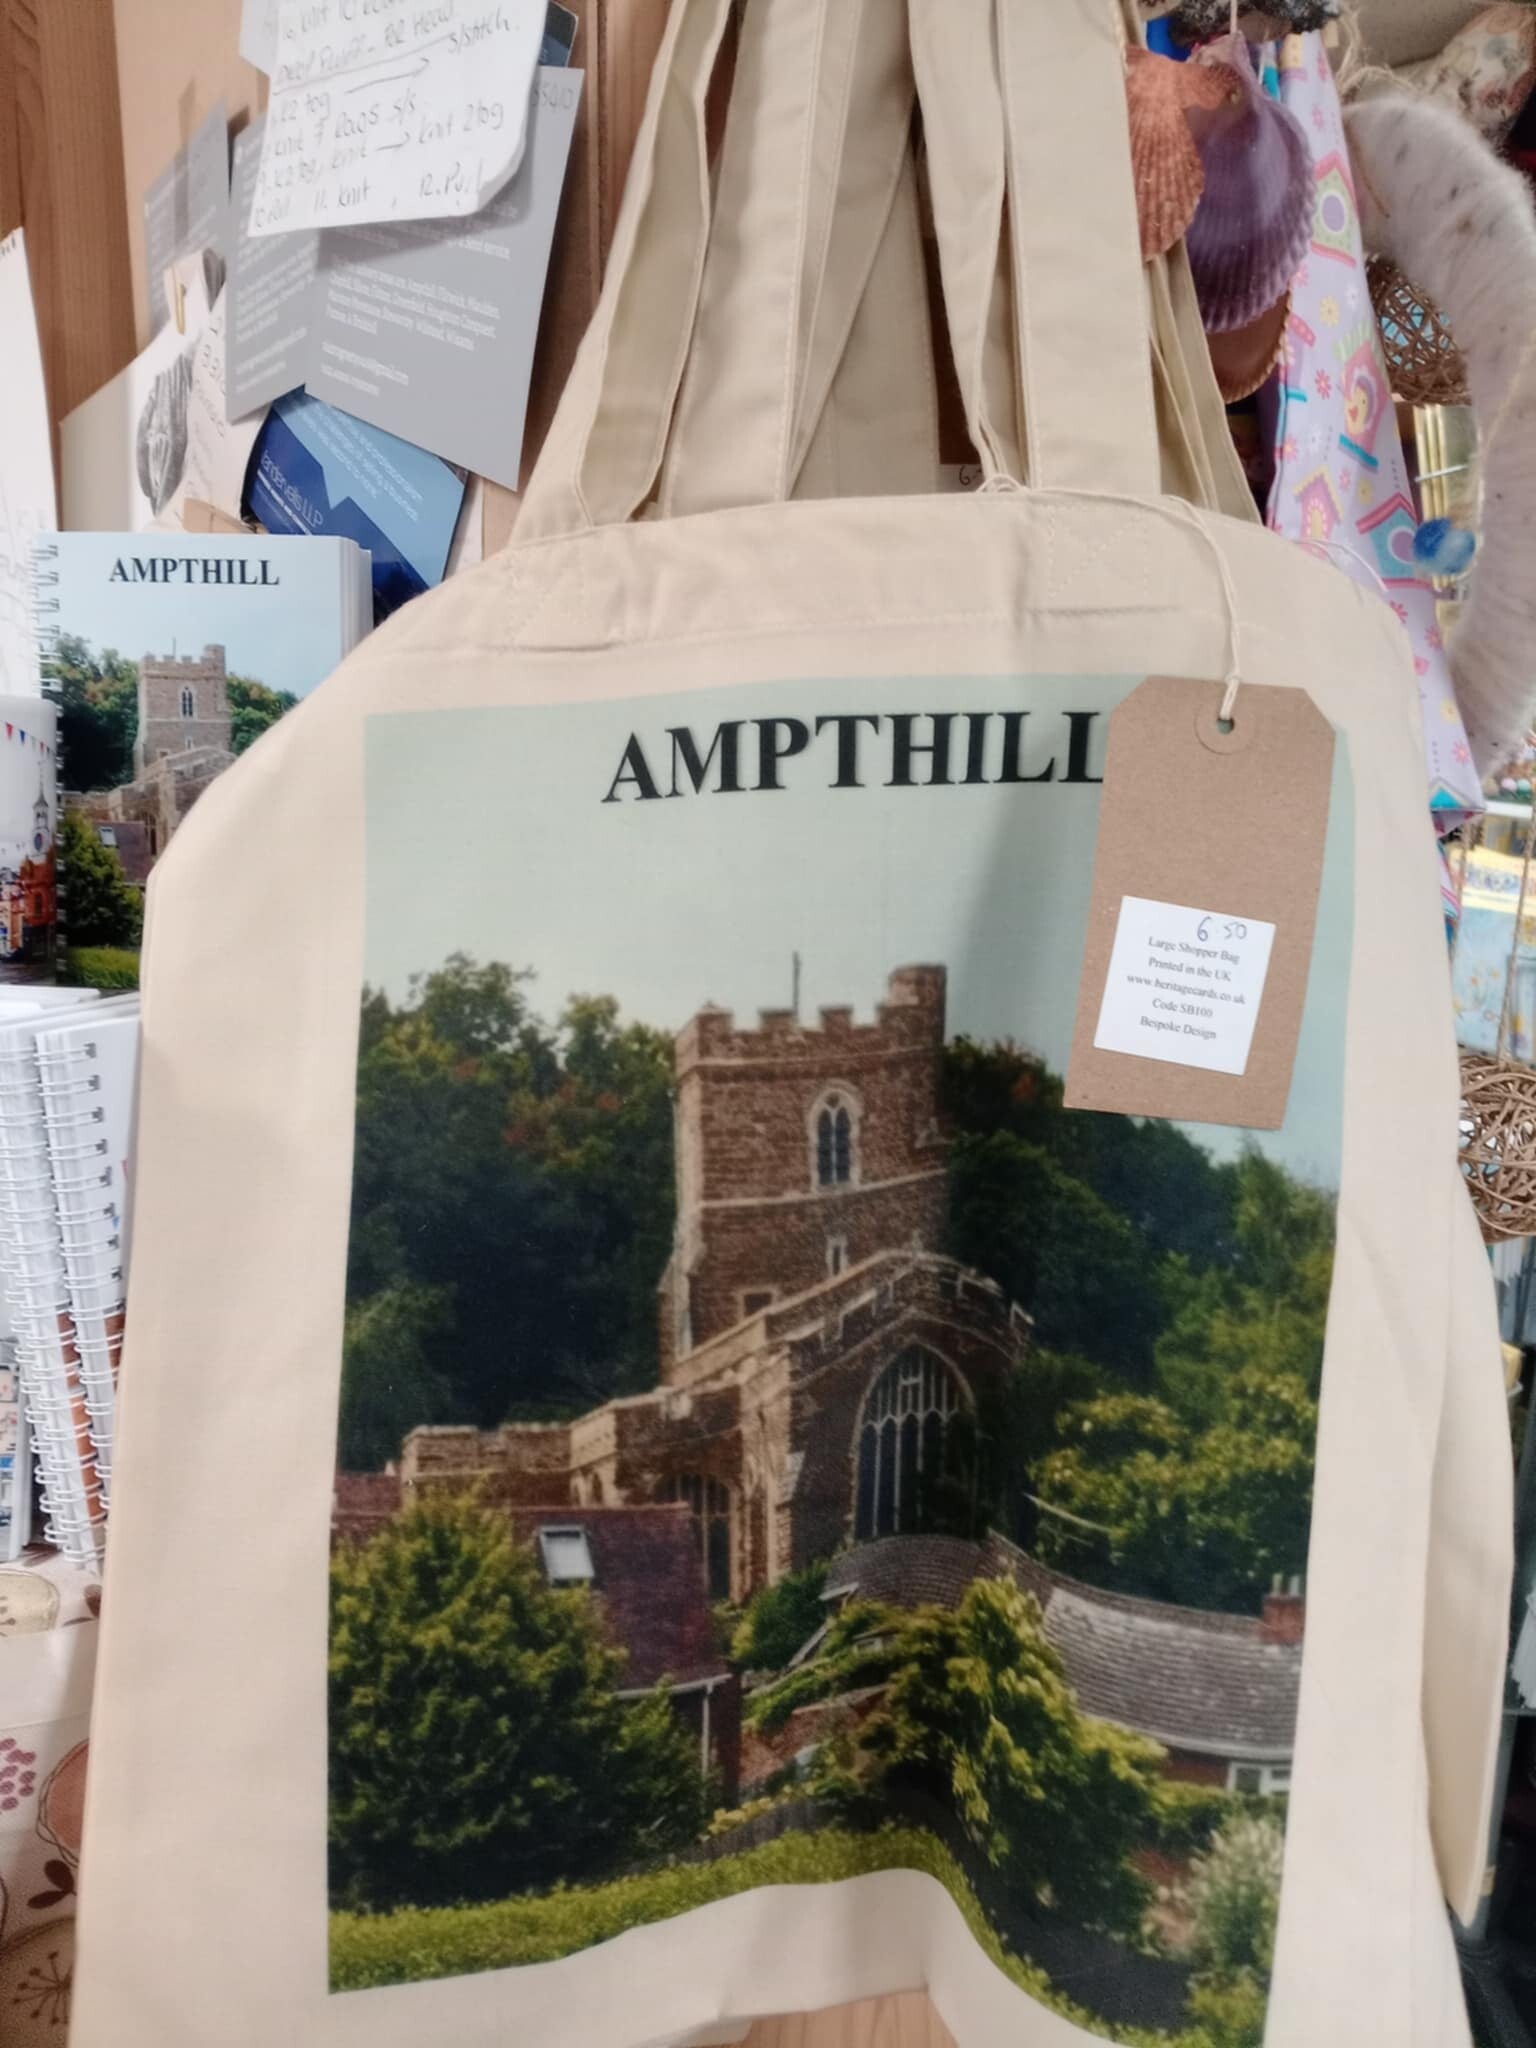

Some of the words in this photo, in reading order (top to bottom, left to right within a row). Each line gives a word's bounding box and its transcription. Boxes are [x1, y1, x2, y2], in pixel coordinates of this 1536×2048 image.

[108, 557, 280, 586] AMPTHILL
[1147, 936, 1177, 952] Large
[1178, 942, 1218, 960] Shopper
[1220, 950, 1241, 965] Bag
[1148, 957, 1184, 973] Printed
[1197, 965, 1213, 978] the
[1214, 969, 1232, 982] UK
[1151, 998, 1178, 1012] Code
[1140, 1015, 1182, 1033] Bespoke
[1183, 1023, 1217, 1041] Design
